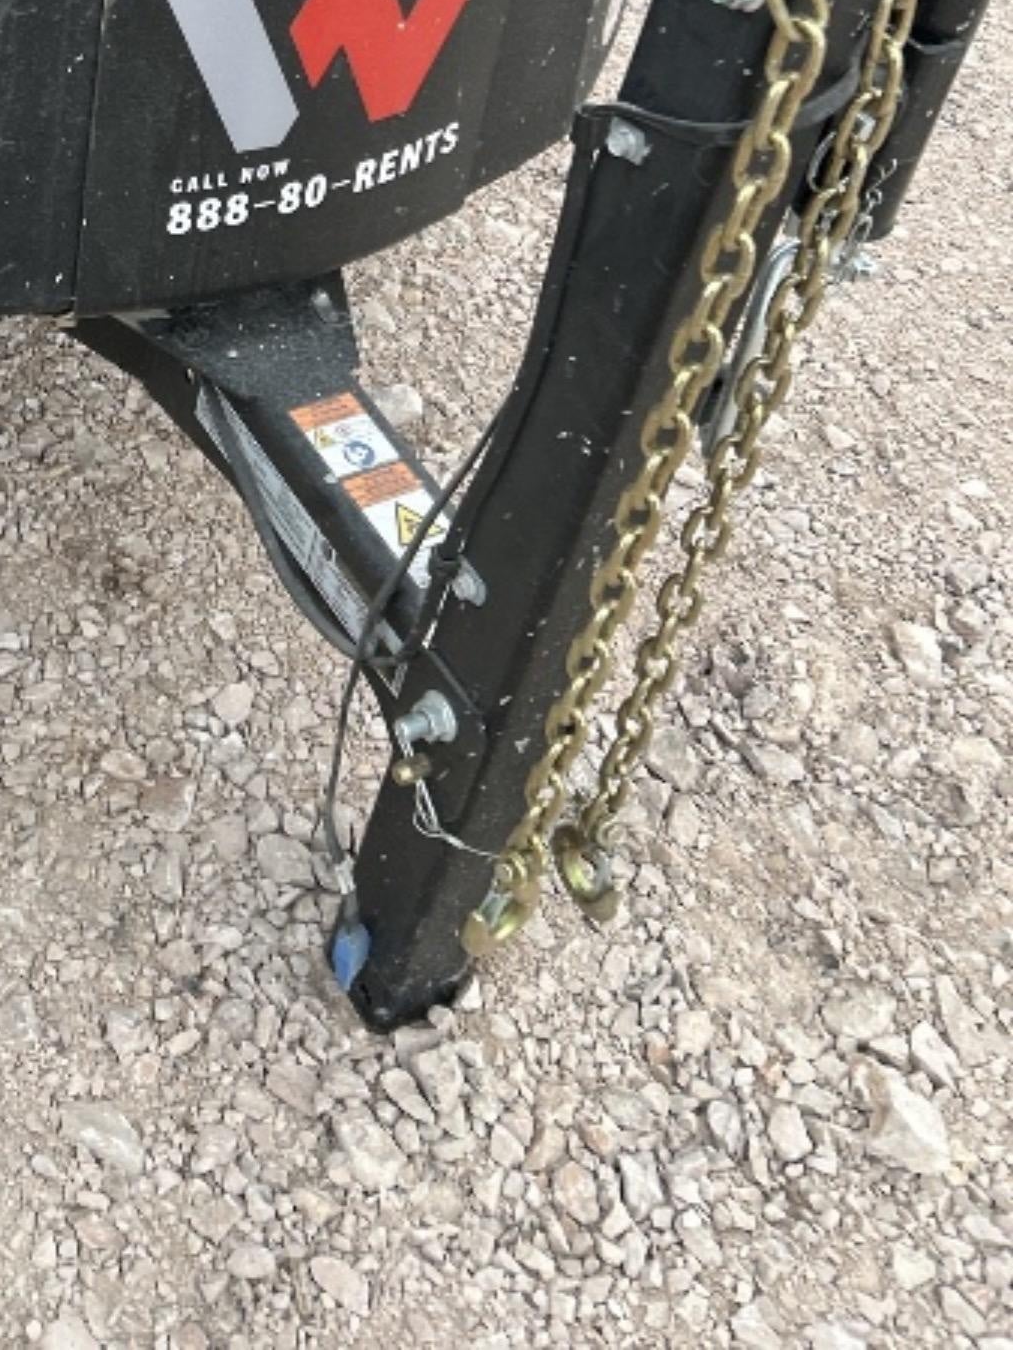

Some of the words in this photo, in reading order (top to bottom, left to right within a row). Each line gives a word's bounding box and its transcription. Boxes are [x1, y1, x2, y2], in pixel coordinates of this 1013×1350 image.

[166, 121, 460, 235] 888-80-RENTS
[169, 171, 229, 195] CALL
[239, 158, 291, 185] NOW
